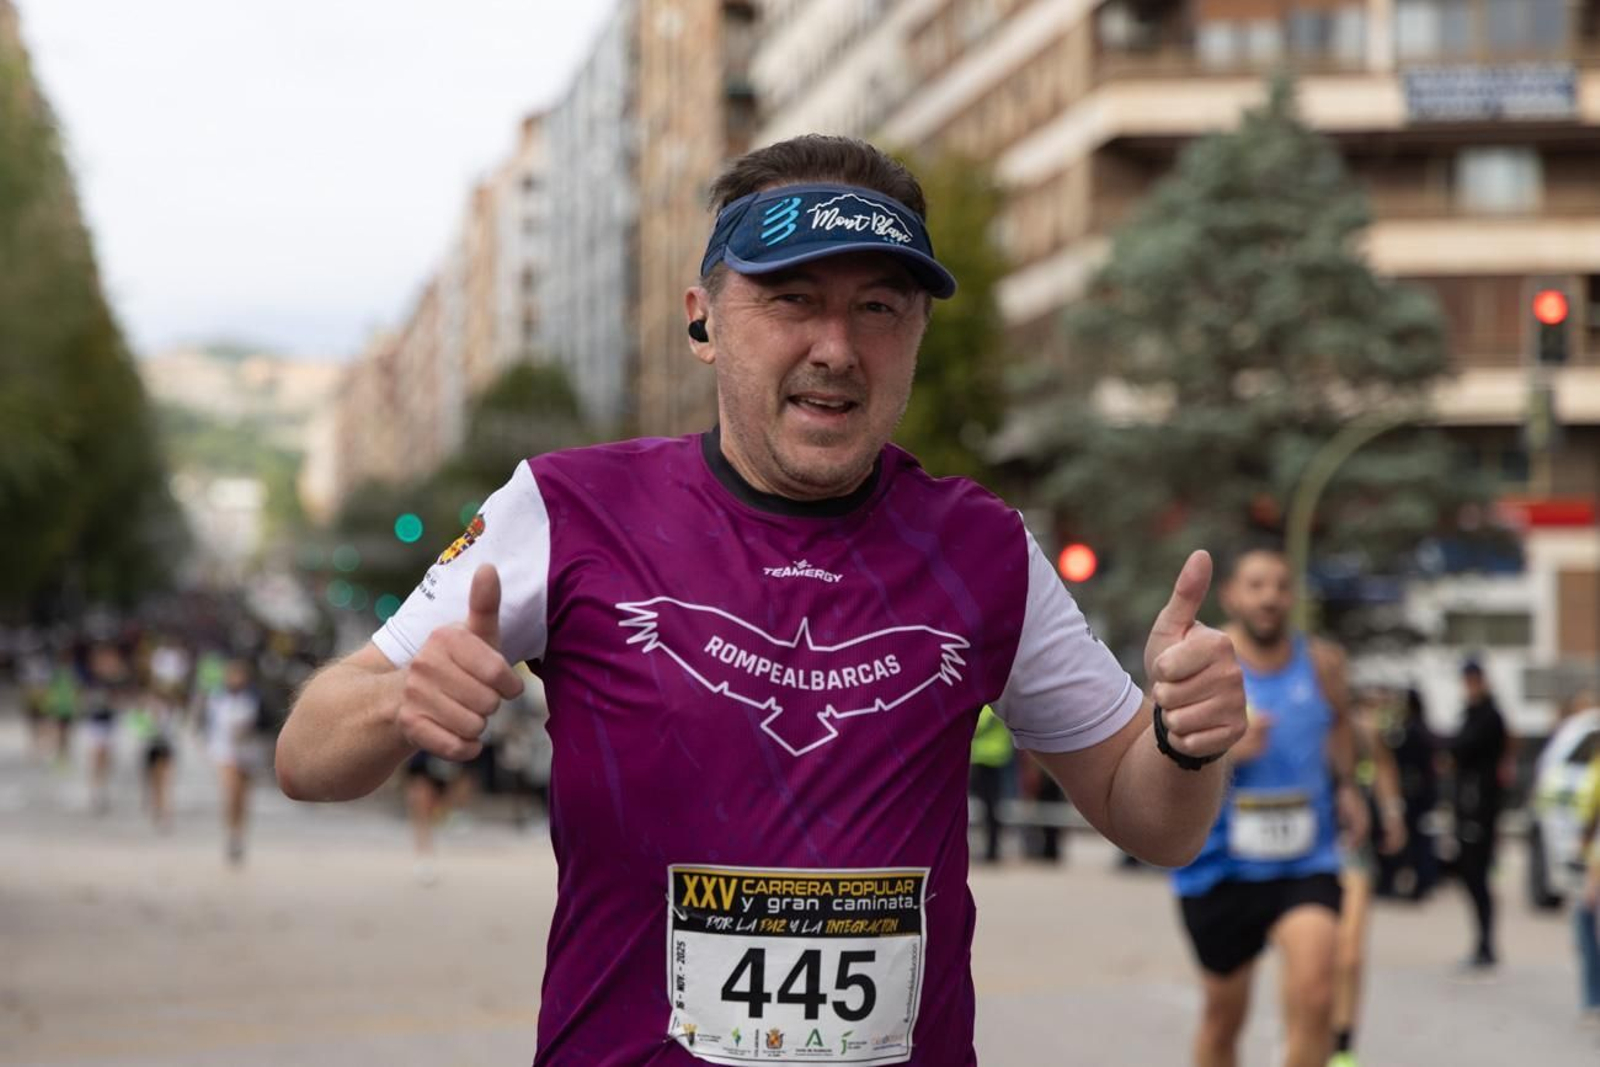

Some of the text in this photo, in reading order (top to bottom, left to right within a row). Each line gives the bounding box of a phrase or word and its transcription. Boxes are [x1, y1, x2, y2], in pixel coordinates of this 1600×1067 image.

[812, 208, 870, 231] Mont
[763, 567, 843, 583] TEAMERGY
[704, 635, 902, 691] ROMPEALBARCAS
[682, 875, 738, 911] XXV
[742, 880, 914, 896] CARRERA POPULAR
[741, 897, 754, 913] y
[767, 898, 819, 914] gran
[705, 916, 734, 930] POR
[735, 918, 758, 933] LA
[759, 919, 787, 933] PAZ
[801, 920, 823, 934] LA
[676, 941, 686, 965] 2025
[721, 947, 877, 1022] 445
